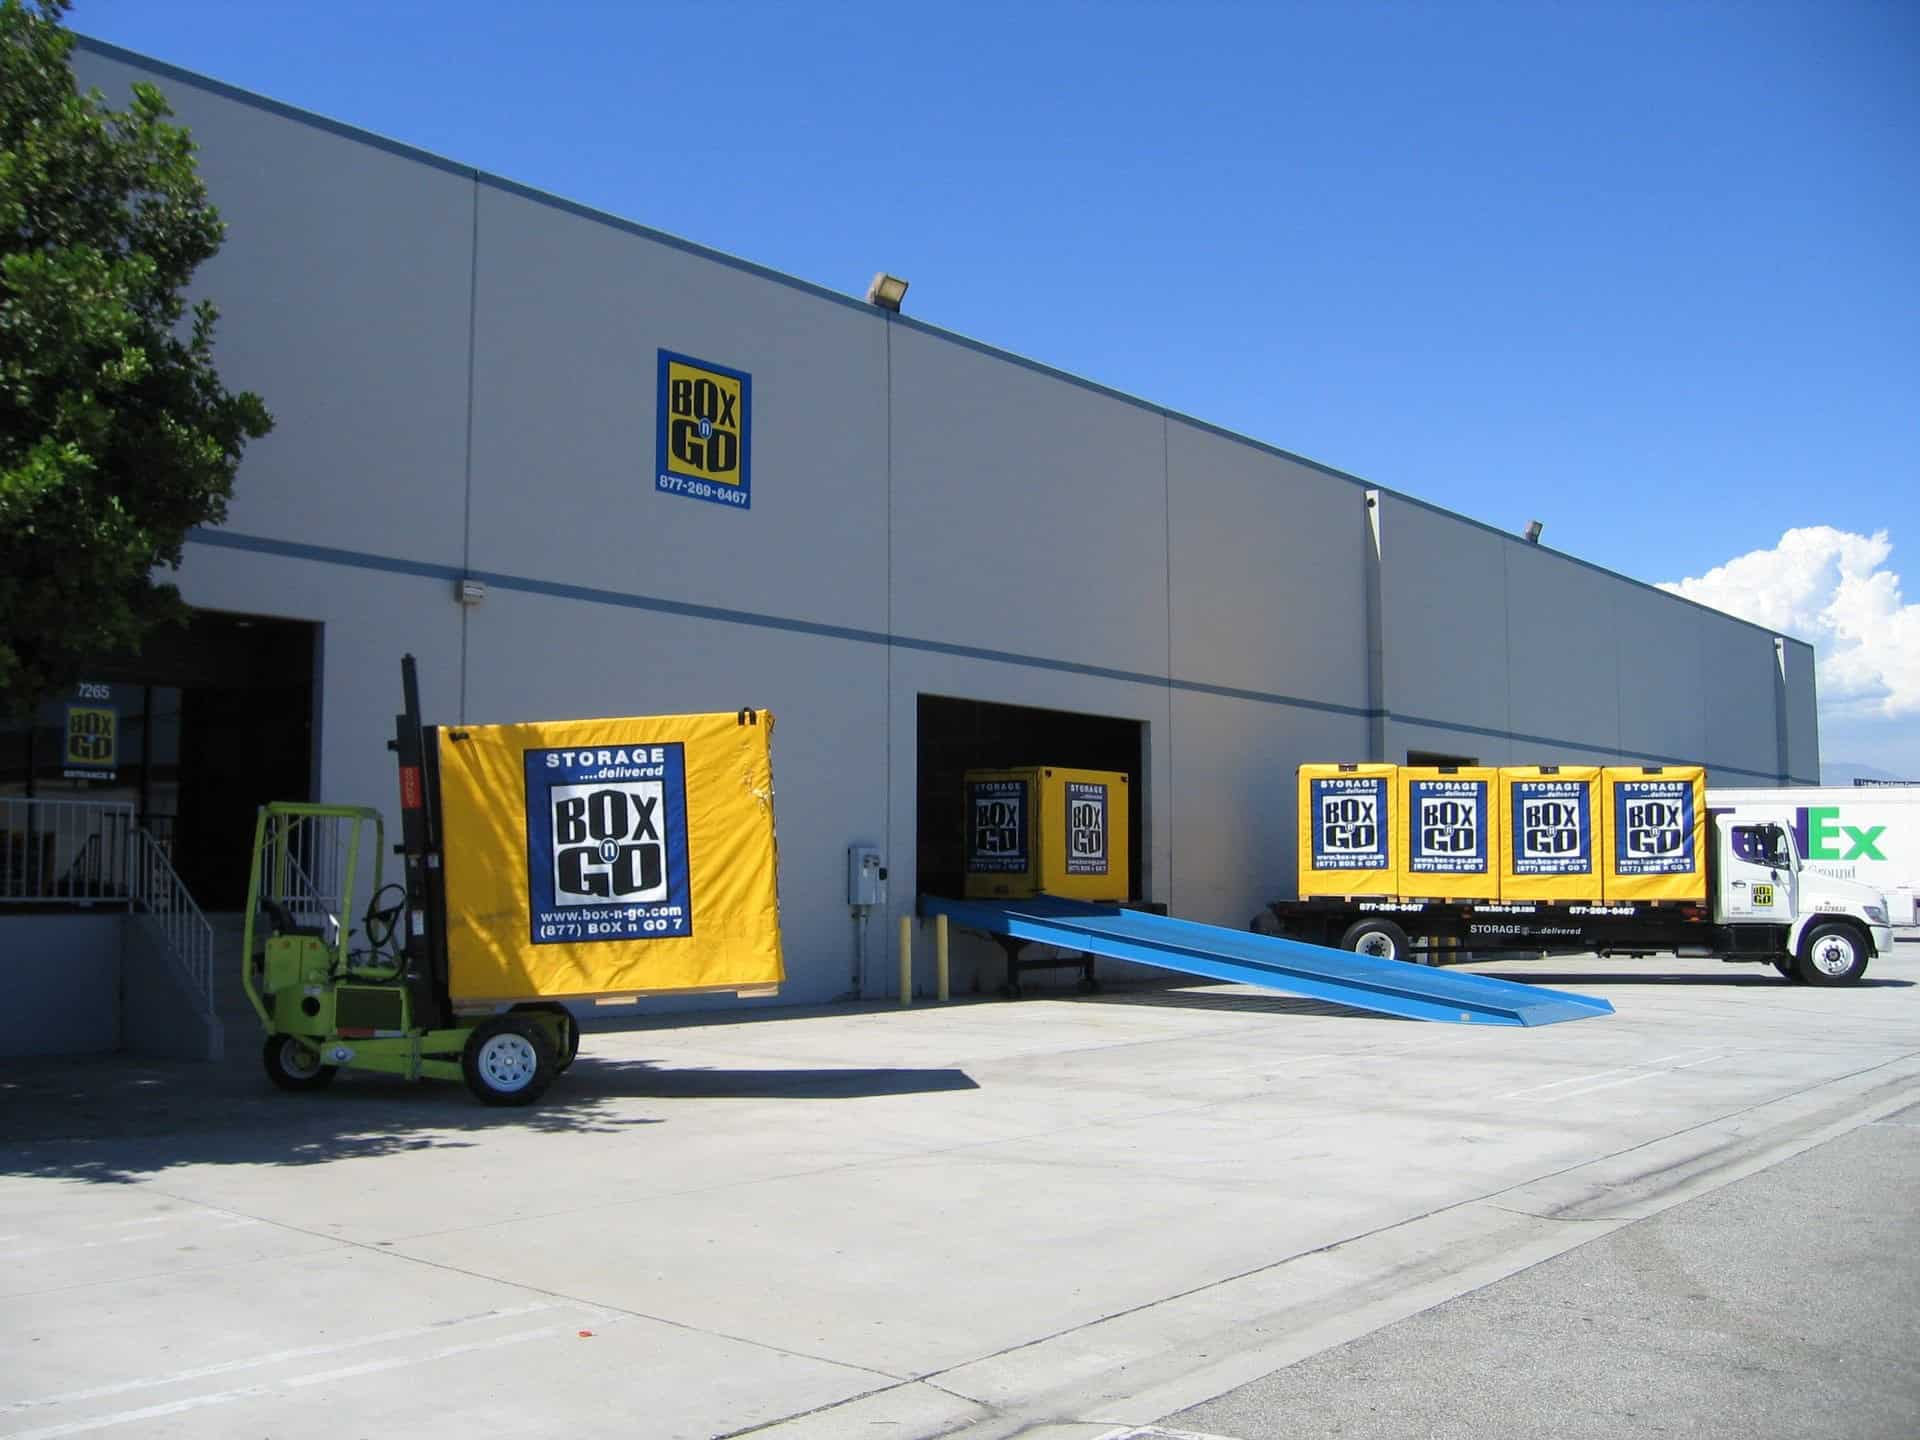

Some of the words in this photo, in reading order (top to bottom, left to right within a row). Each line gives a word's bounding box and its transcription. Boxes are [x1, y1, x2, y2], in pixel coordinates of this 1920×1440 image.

[672, 379, 736, 428] BOX
[701, 421, 710, 436] n
[672, 419, 737, 473] GO
[660, 475, 748, 505] 877-269-6467
[79, 683, 110, 699] 7265
[70, 712, 112, 737] BOX
[546, 748, 665, 768] STORAGE
[1320, 780, 1378, 788] STORAGE
[1420, 782, 1478, 790] STORAGE
[1521, 783, 1580, 791] STORAGE
[1624, 783, 1684, 791] STORAGE
[556, 789, 659, 844] BOX
[977, 803, 1016, 827] BOX
[1073, 804, 1100, 829] BOX
[1325, 799, 1374, 824] BOX
[1424, 801, 1473, 826] BOX
[1526, 802, 1576, 828] BOX
[1629, 802, 1679, 828] BOX
[977, 829, 1017, 853] GO
[1073, 829, 1101, 854] GO
[1326, 824, 1375, 849] GO
[1424, 828, 1474, 852] GO
[1526, 829, 1577, 854] GO
[1629, 829, 1681, 855] GO
[604, 842, 615, 858] n
[558, 843, 662, 897] GO
[1753, 895, 1771, 904] GO
[540, 906, 682, 923] www.box-n-go.com
[540, 923, 582, 937] (877)
[588, 921, 622, 935] BOX
[628, 922, 638, 932] n
[643, 919, 668, 932] GO
[673, 918, 683, 930] 7
[1470, 925, 1521, 934] STORAGE
